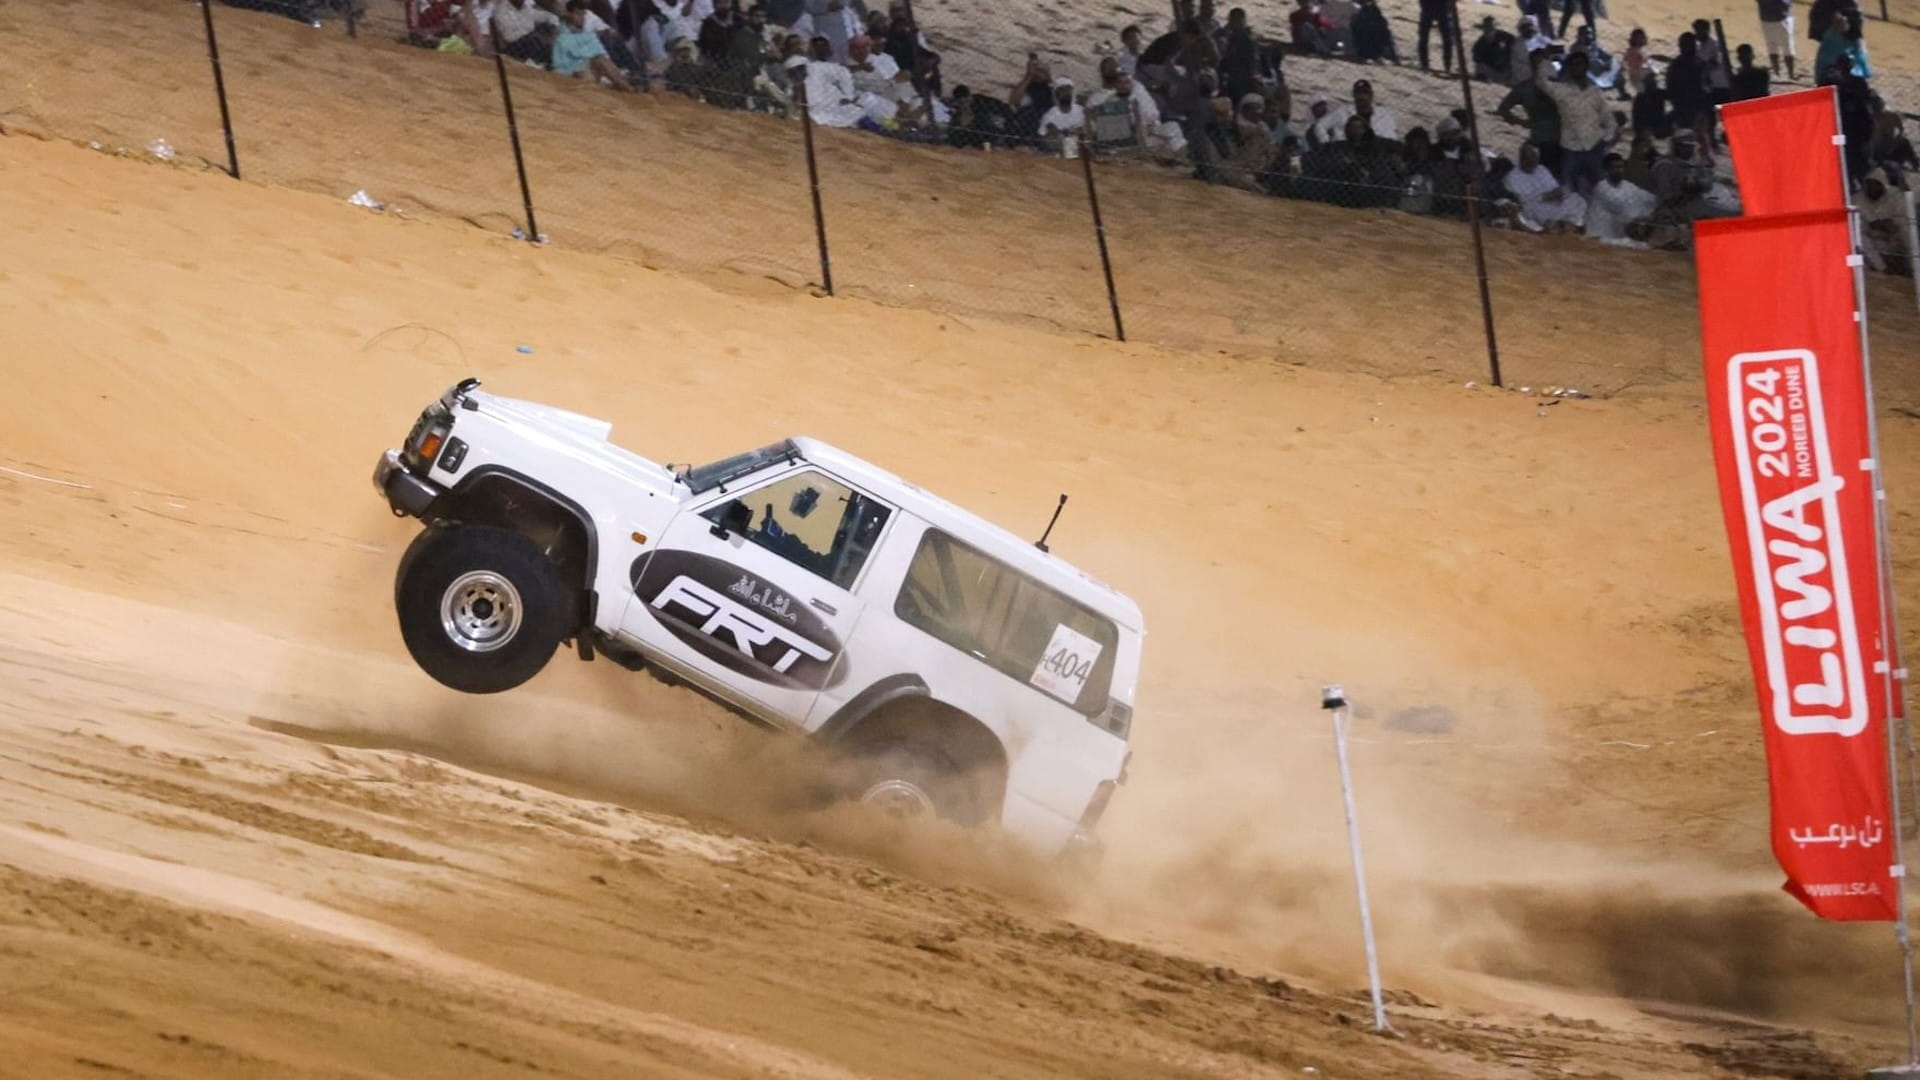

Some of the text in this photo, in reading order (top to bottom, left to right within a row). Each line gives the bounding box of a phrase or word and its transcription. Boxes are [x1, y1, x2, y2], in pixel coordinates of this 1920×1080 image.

[1746, 367, 1790, 477] 2024
[1784, 365, 1812, 477] MOREEB DUNE
[650, 575, 833, 673] FRT
[1761, 476, 1845, 708] LIWA
[1050, 647, 1092, 686] 404
